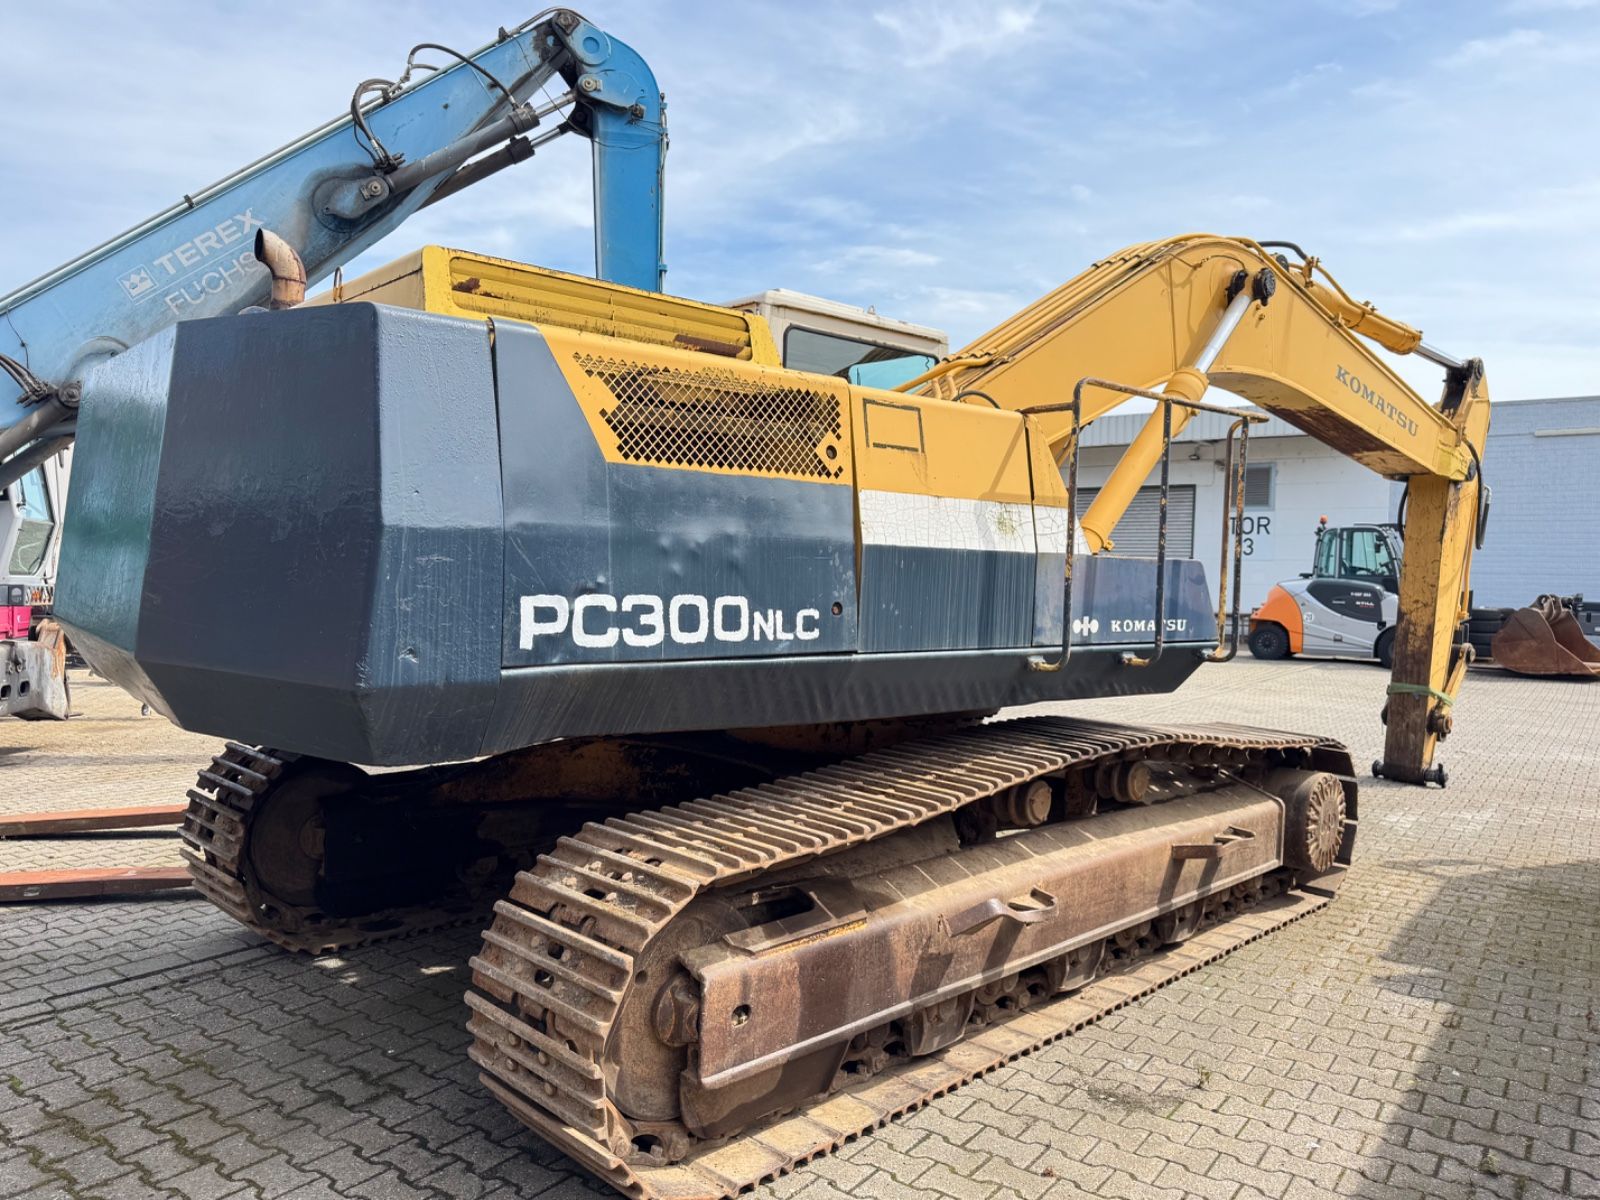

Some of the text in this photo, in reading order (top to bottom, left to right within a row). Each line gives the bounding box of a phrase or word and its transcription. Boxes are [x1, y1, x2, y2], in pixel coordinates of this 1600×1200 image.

[153, 208, 264, 275] TEREX
[164, 251, 260, 316] FUCHS
[1335, 364, 1419, 437] KOMATSU
[1110, 619, 1188, 633] KOMASU
